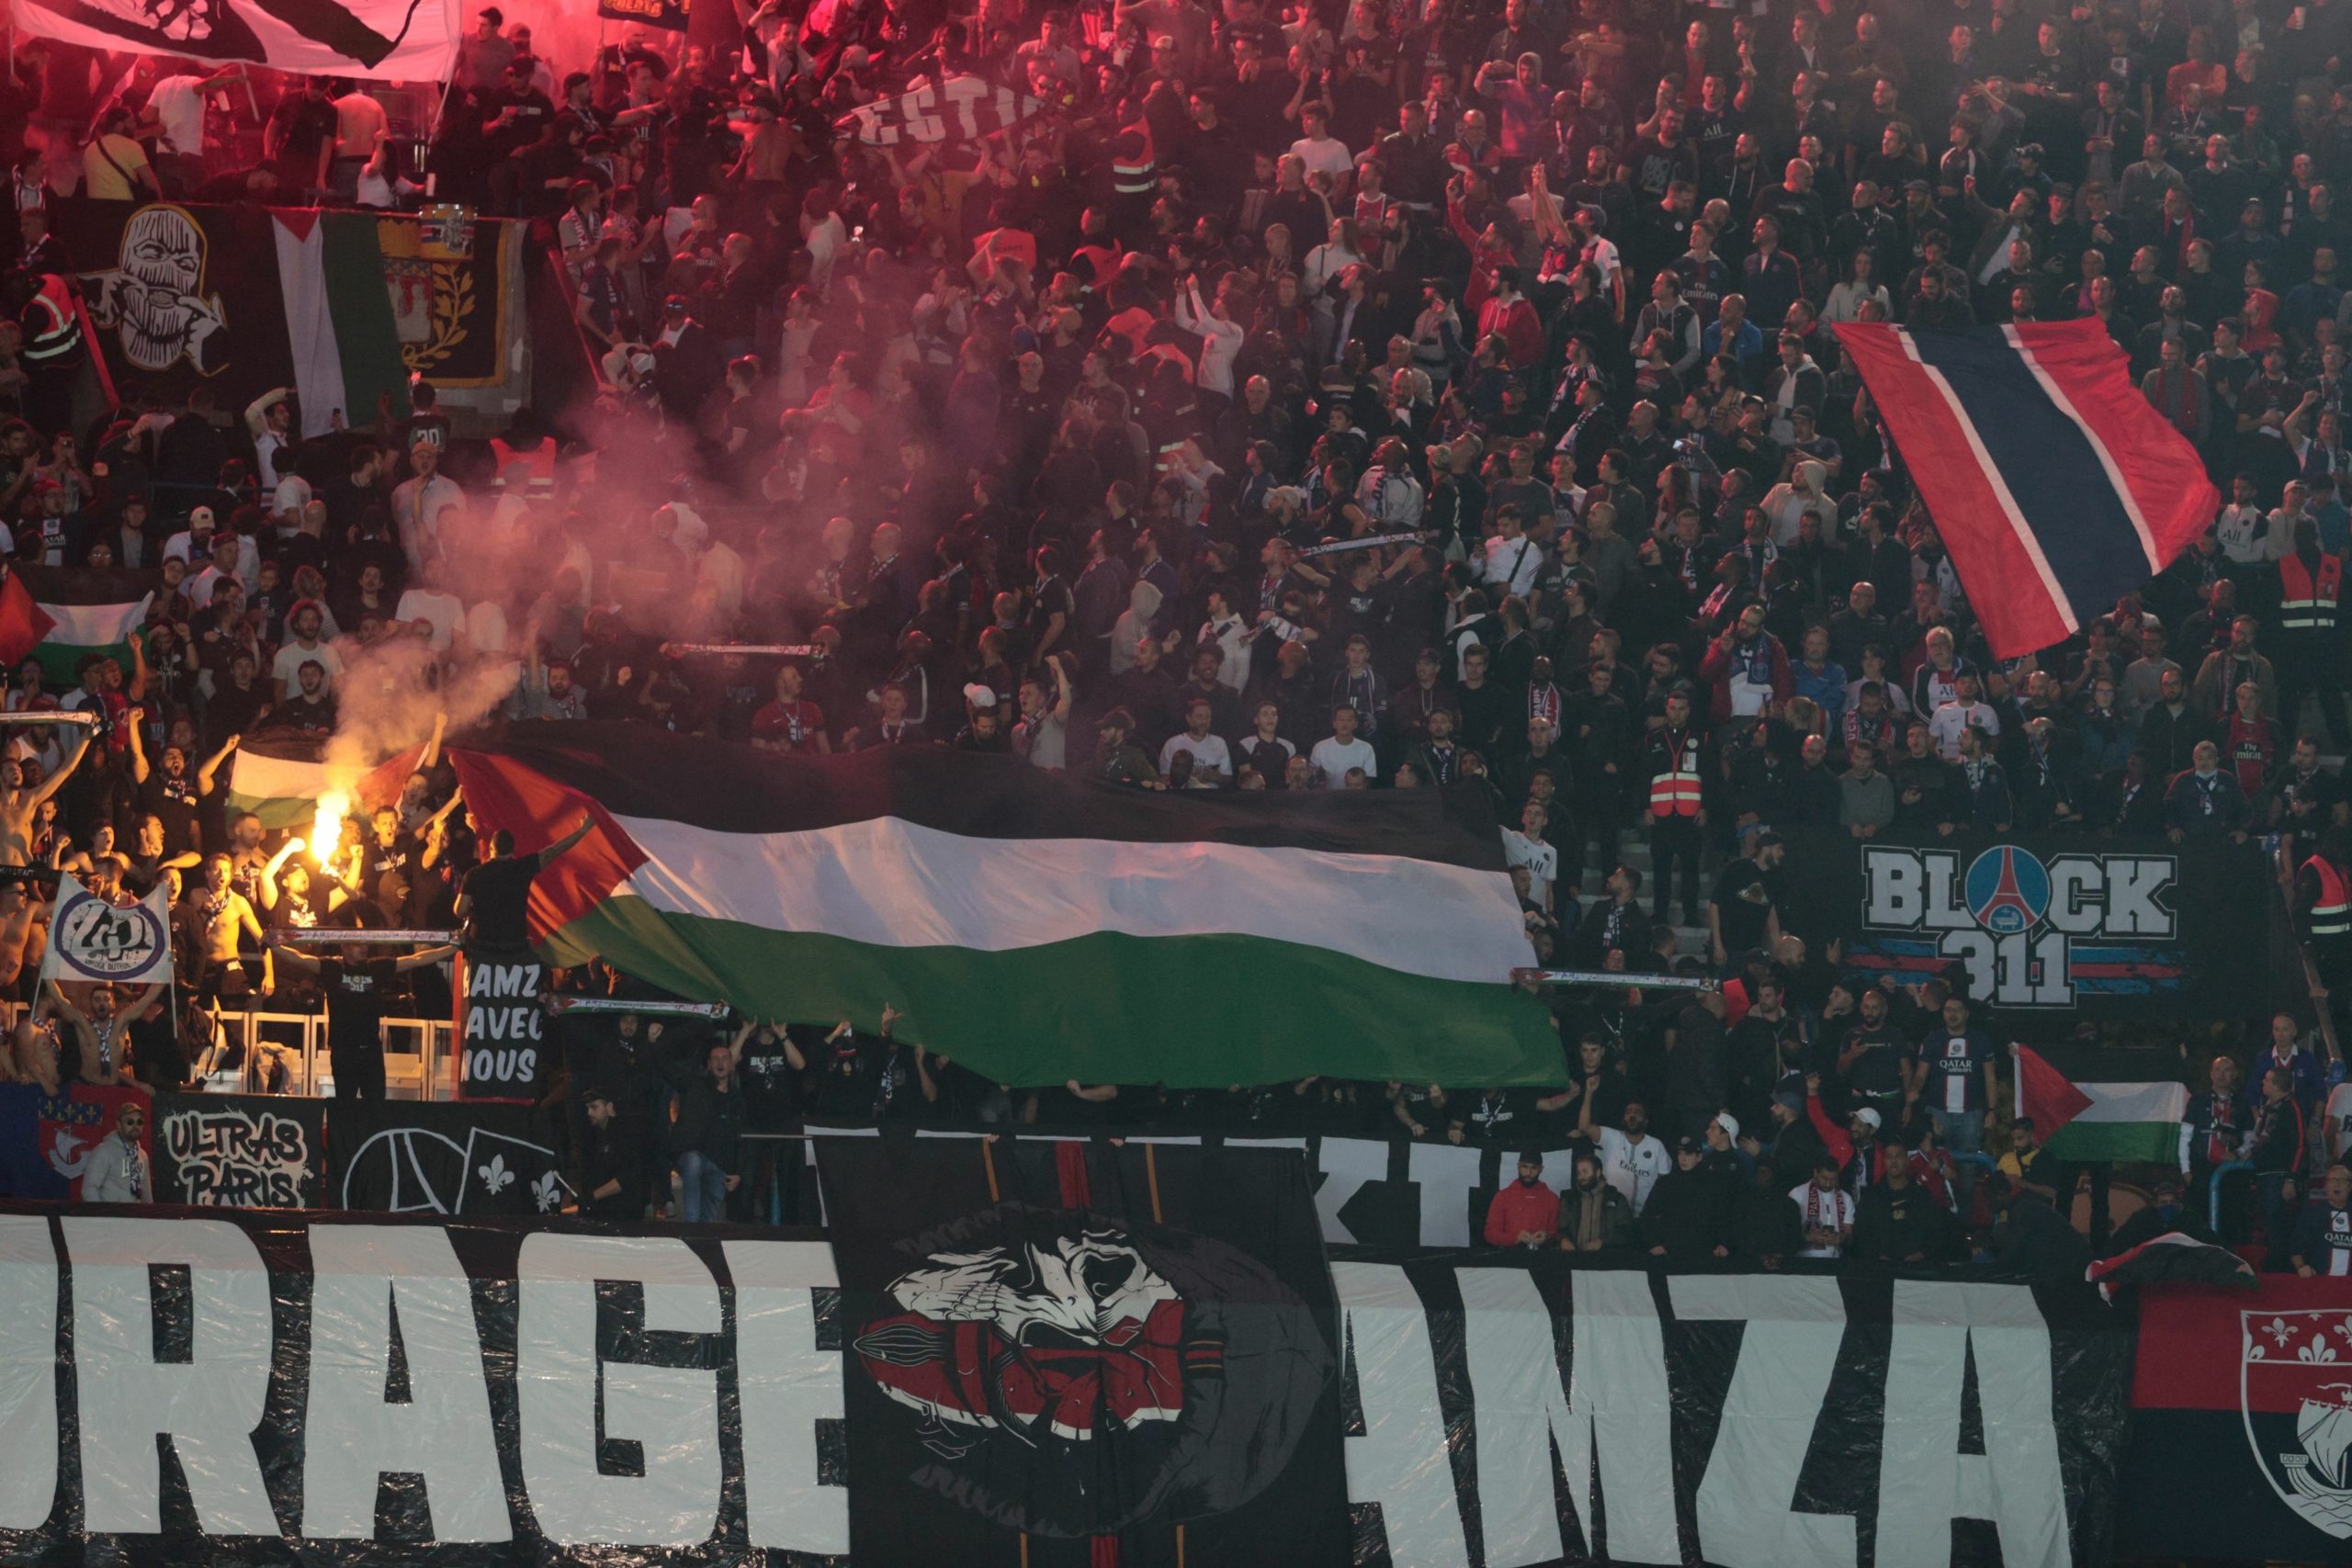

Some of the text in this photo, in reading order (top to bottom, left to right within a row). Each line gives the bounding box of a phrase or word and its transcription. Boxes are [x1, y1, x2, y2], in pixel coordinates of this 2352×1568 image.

[1682, 289, 1718, 301] Emirates
[2234, 750, 2264, 761] mirat
[1863, 845, 2177, 937] BLOCK
[462, 962, 541, 998] AMZ
[1940, 931, 2076, 1009] 311
[1939, 1059, 1973, 1070] QATAR
[168, 1112, 303, 1162] ULTRAS
[182, 1159, 300, 1208] PARIS
